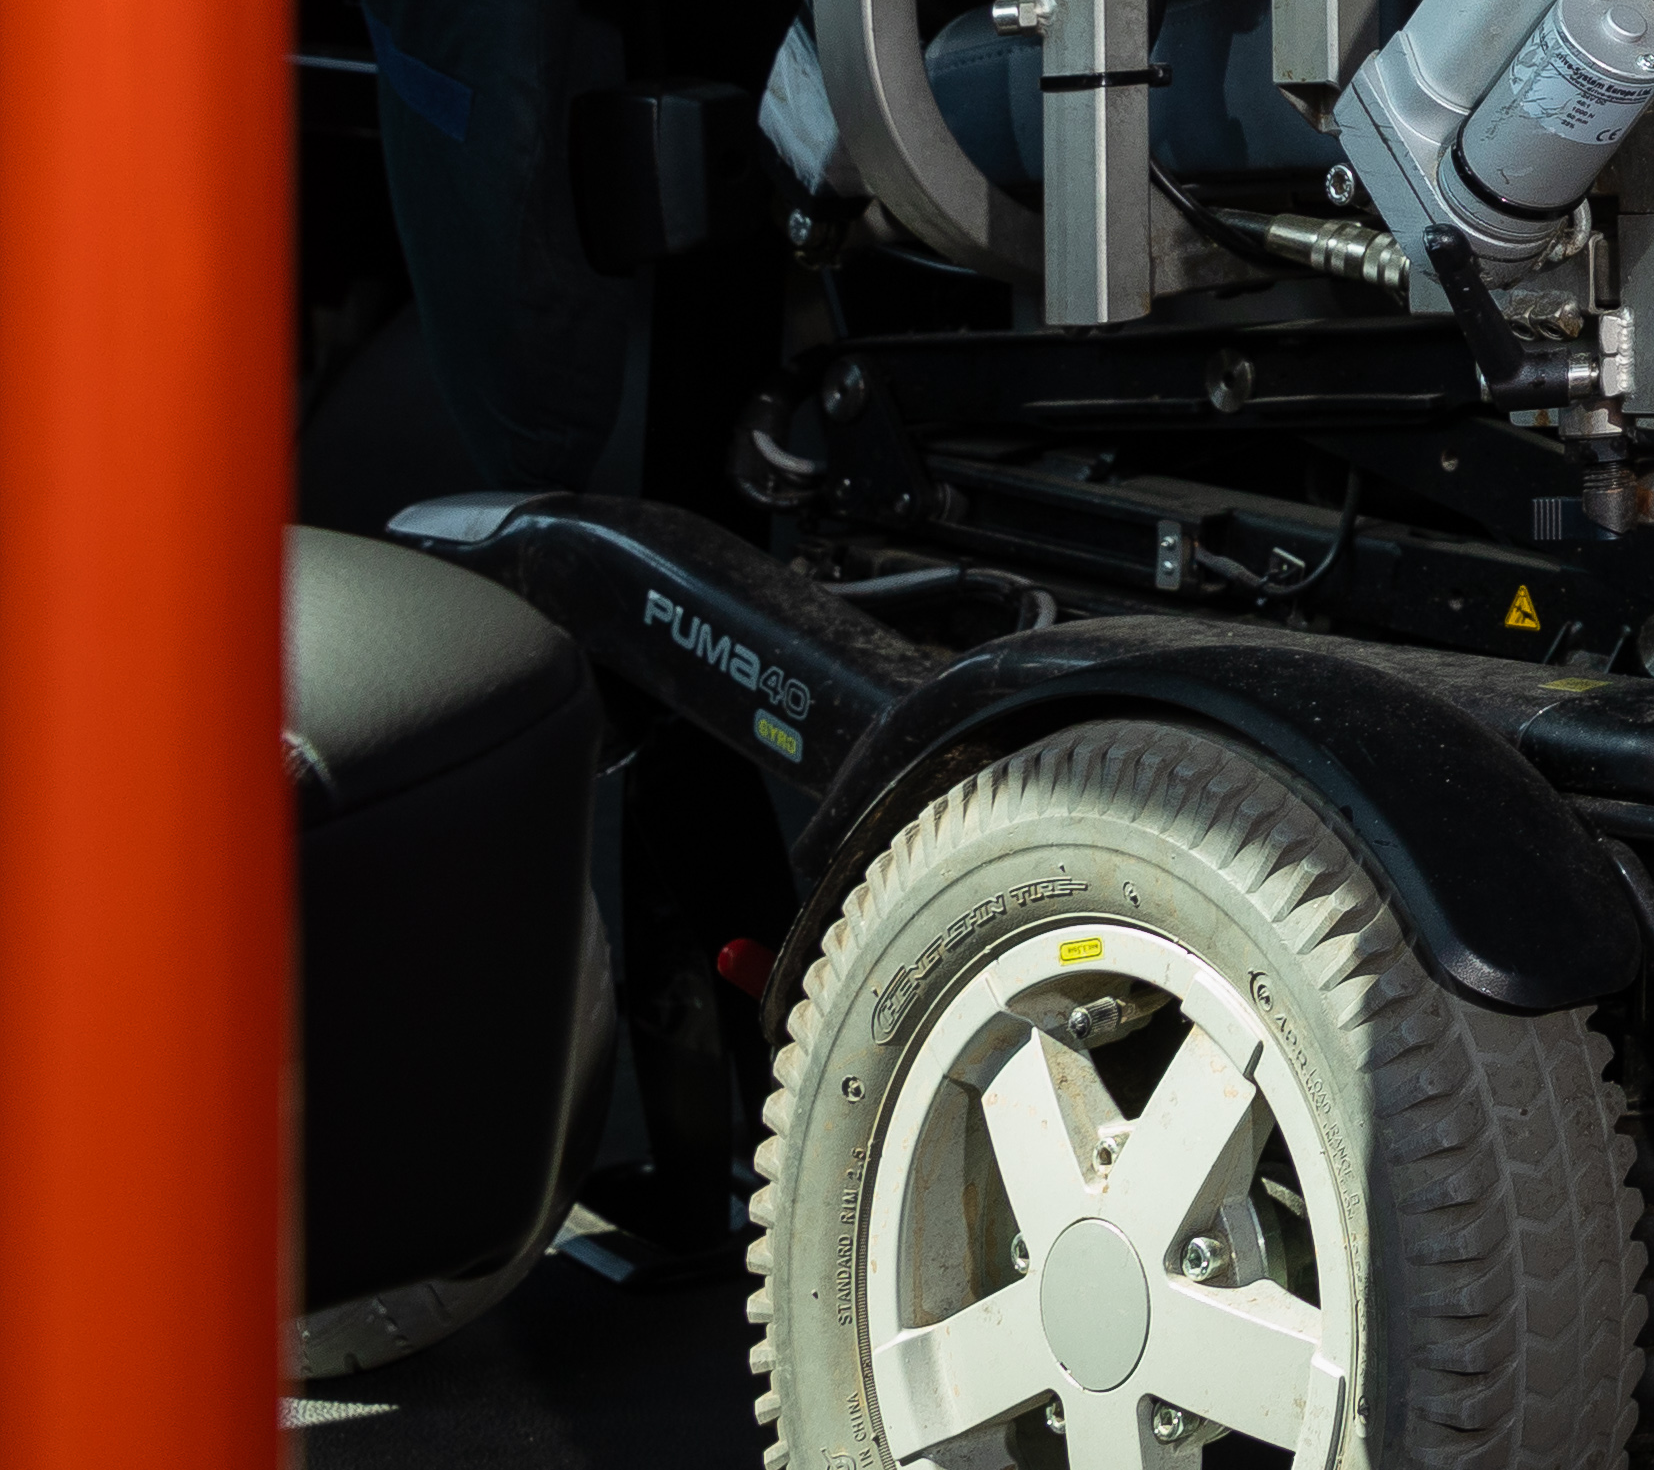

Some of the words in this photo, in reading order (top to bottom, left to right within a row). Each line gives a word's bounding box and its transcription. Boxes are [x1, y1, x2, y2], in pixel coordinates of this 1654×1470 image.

[1009, 876, 1088, 906] TIRE
[840, 1188, 858, 1225] RIM
[836, 1233, 853, 1327] STANDARD
[846, 1391, 867, 1442] CHINA
